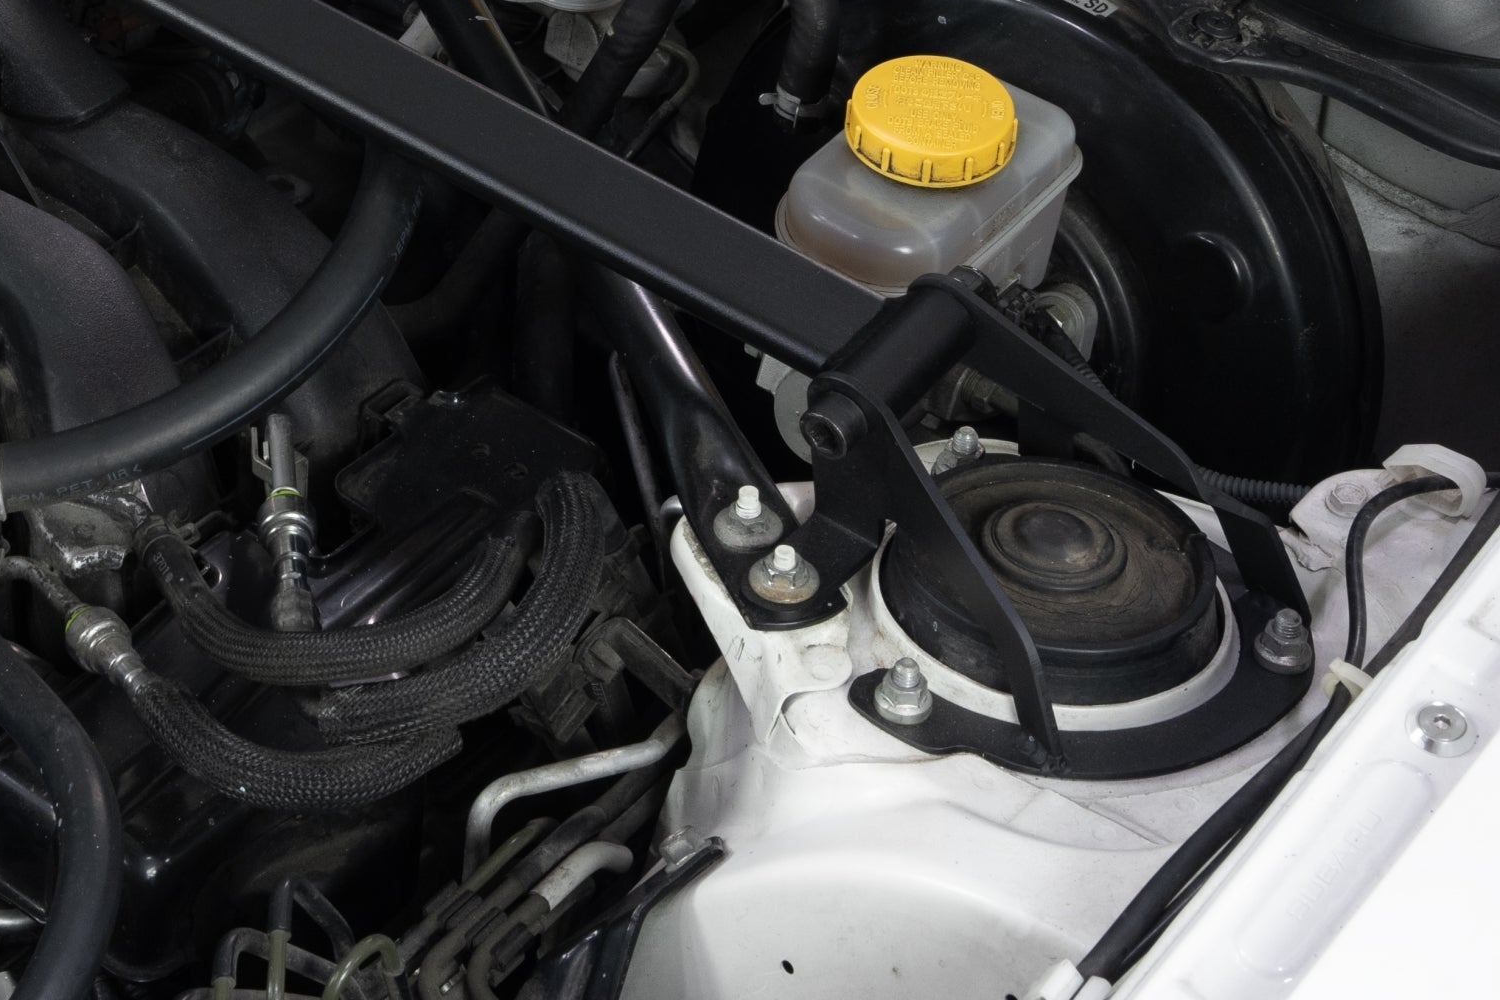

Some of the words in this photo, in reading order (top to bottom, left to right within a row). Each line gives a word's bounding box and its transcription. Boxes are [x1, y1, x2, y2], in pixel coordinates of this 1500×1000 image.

[914, 58, 963, 73] WARNING
[893, 74, 929, 86] BEFORE
[932, 76, 982, 92] REMOVING
[910, 108, 930, 119] USE
[933, 109, 958, 123] ONLY
[917, 117, 950, 132] BRAKE
